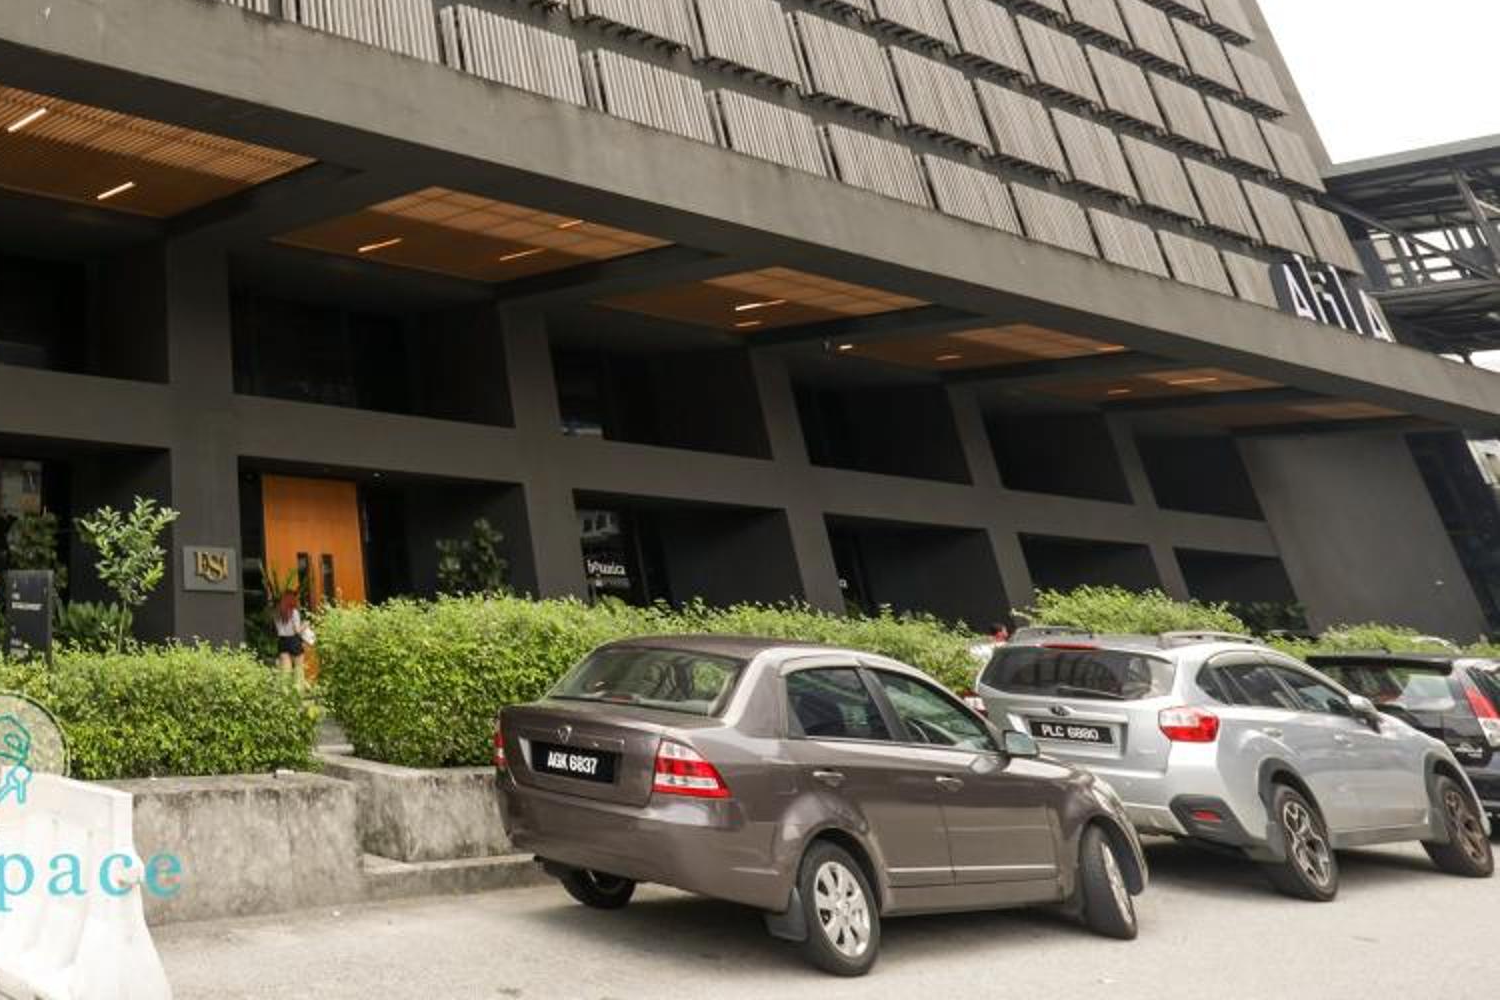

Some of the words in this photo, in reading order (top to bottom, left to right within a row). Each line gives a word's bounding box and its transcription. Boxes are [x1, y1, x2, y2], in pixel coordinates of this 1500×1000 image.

[1041, 723, 1065, 737] PLC
[547, 751, 568, 770] AGK
[569, 754, 598, 775] 6837
